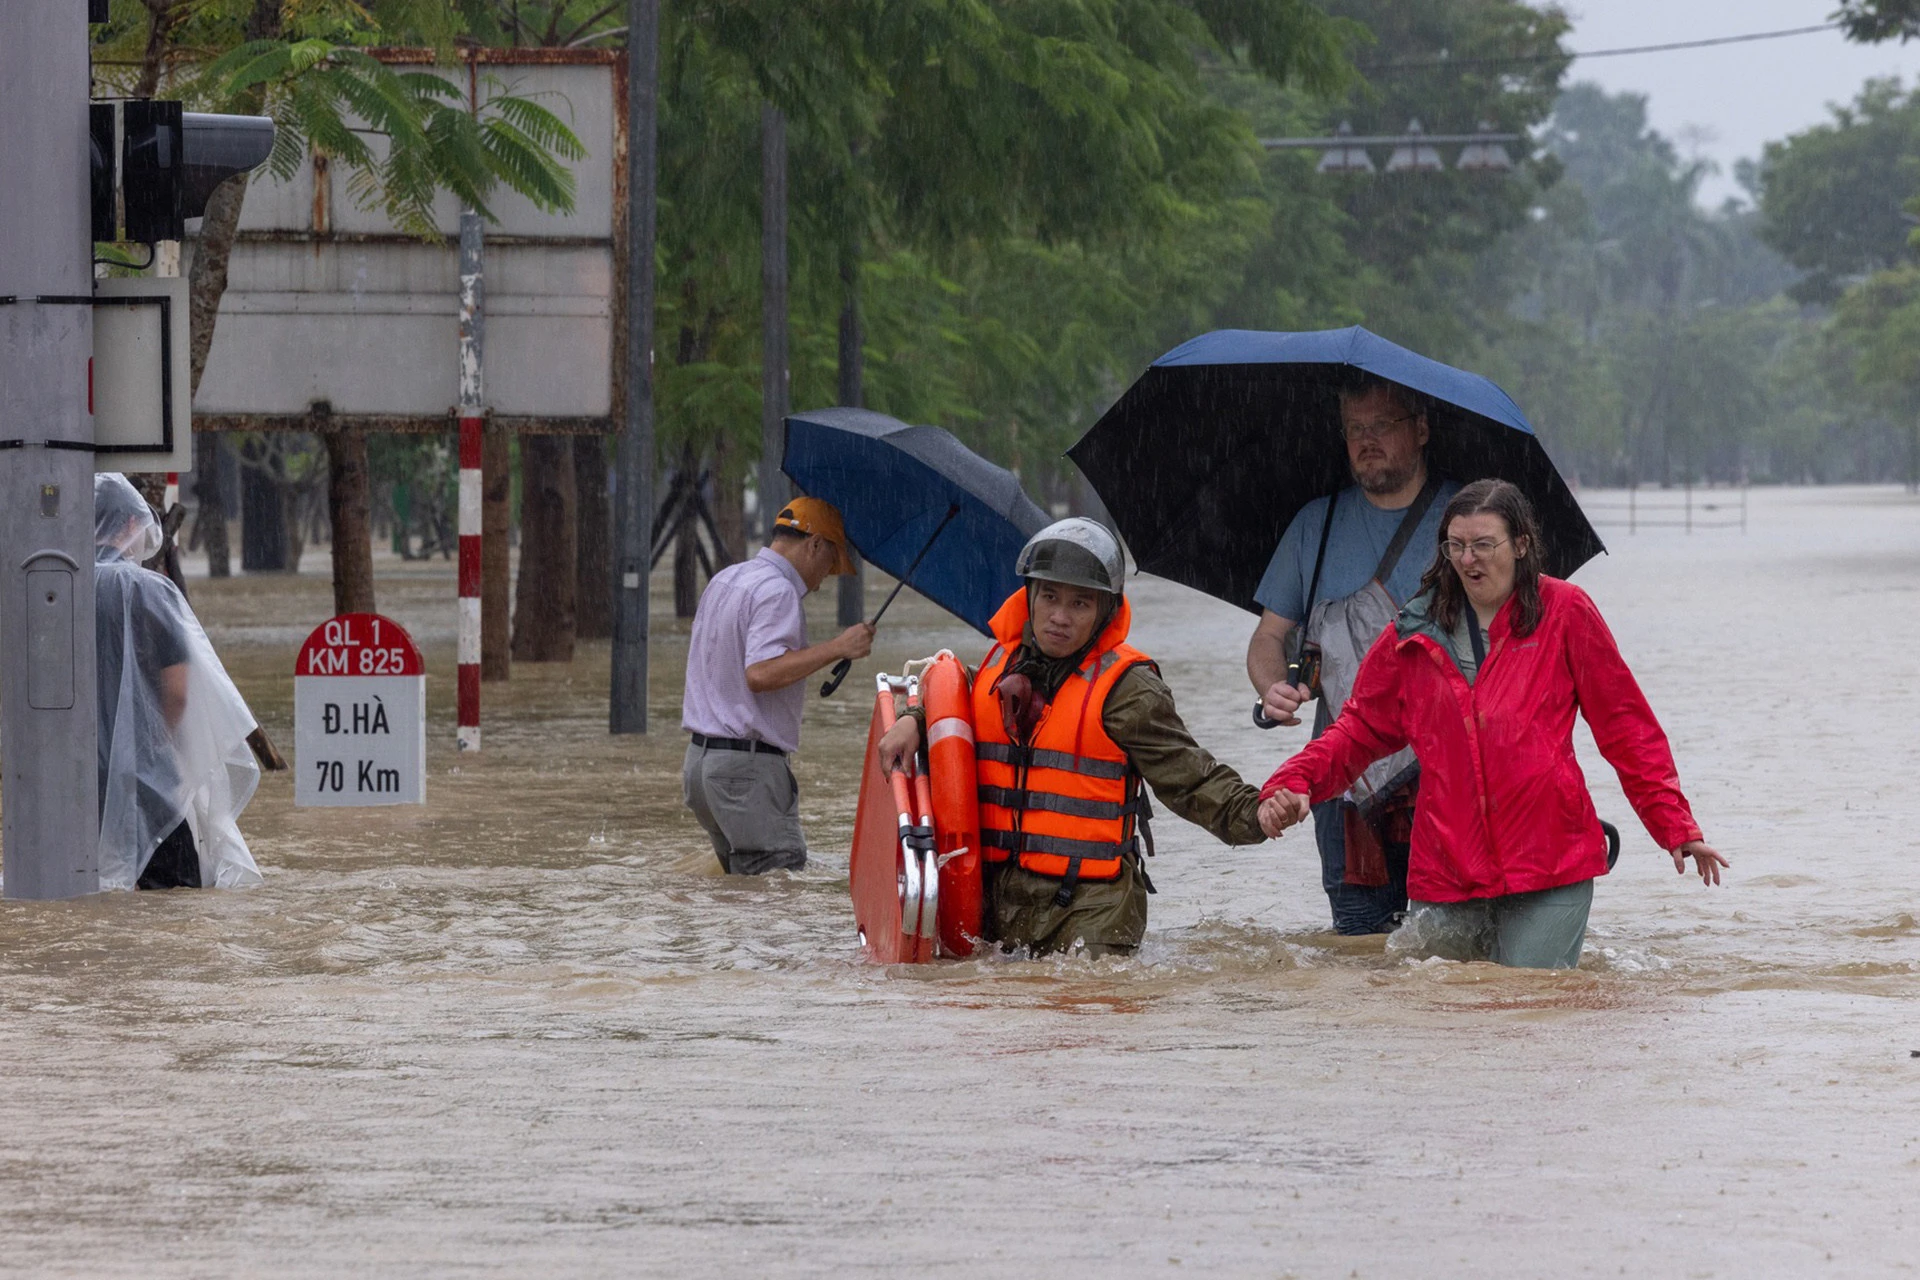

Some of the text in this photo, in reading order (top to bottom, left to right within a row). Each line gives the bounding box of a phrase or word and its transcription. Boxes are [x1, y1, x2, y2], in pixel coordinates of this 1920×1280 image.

[325, 620, 380, 646] QL 1
[309, 648, 404, 674] KM 825
[322, 695, 390, 734] Đ.HÀ
[316, 760, 399, 792] 70 Km
